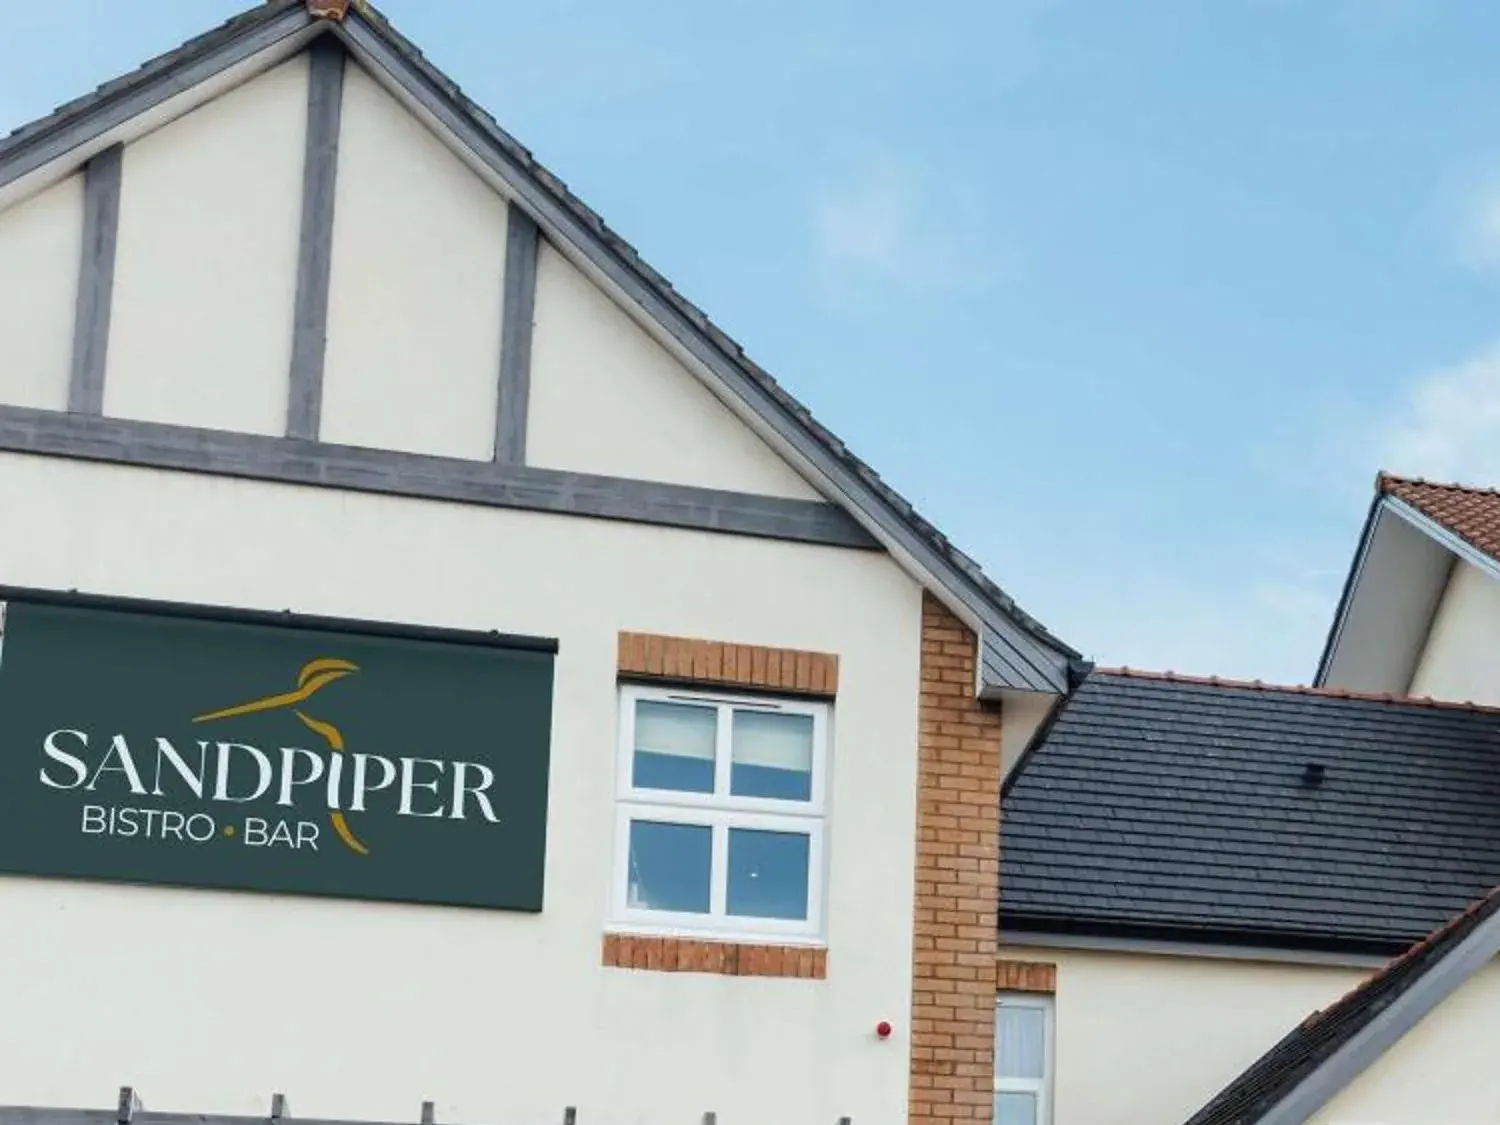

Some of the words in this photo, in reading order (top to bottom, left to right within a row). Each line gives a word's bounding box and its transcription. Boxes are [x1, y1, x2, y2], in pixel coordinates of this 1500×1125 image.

[39, 729, 501, 823] SANDPIPER
[82, 804, 215, 842] BISTRO
[244, 816, 320, 851] BAR
